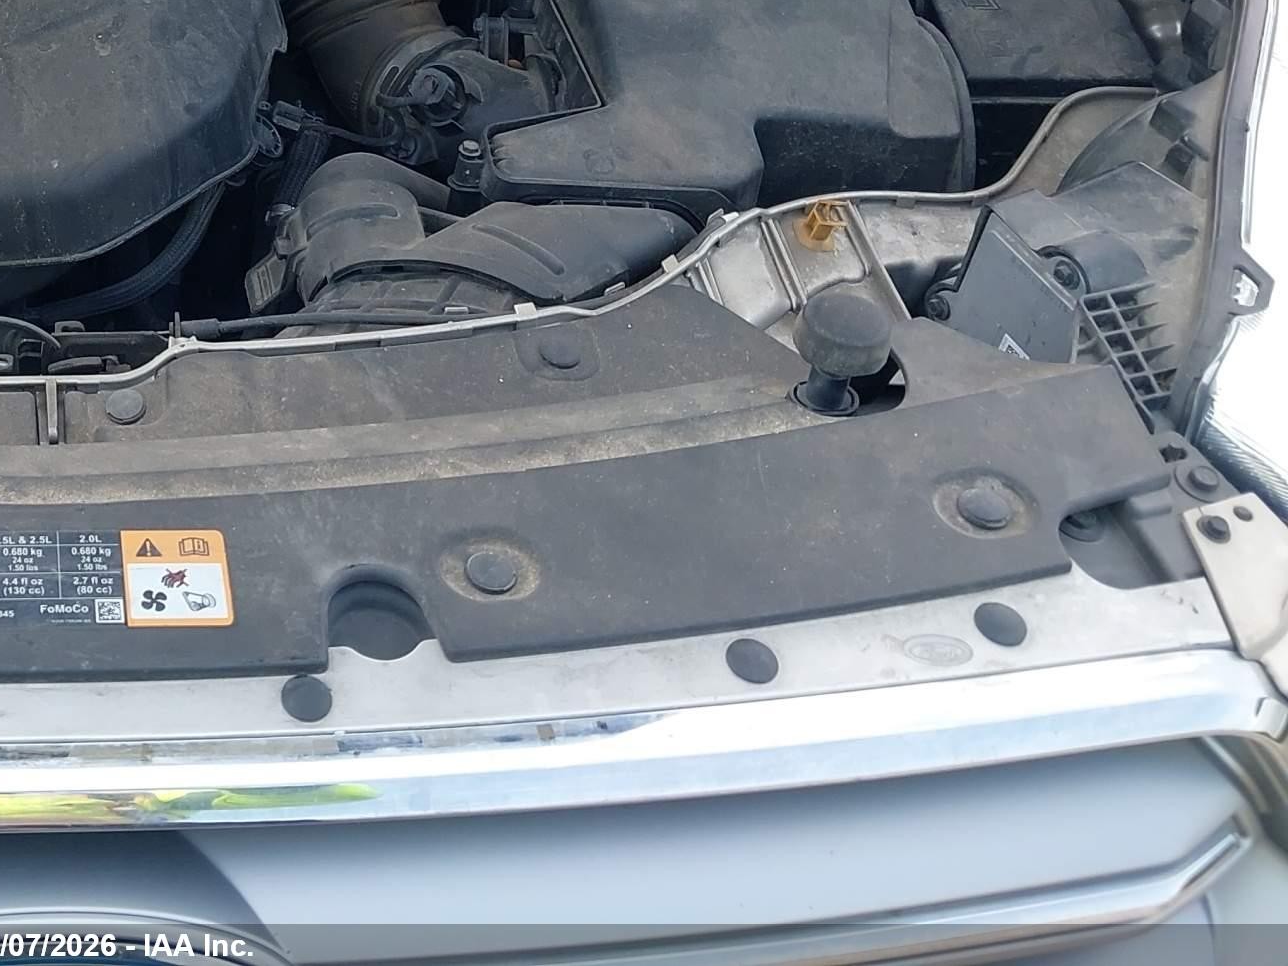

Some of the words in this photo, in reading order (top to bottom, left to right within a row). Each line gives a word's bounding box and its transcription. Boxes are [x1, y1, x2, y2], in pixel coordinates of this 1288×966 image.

[18, 535, 27, 545] &
[28, 535, 53, 544] 2.5L
[79, 534, 102, 544] 2.0L
[2, 547, 28, 557] 0.680
[29, 547, 43, 558] kg
[71, 546, 97, 556] 0.680
[98, 546, 112, 557] kg
[1, 576, 19, 586] 4.4
[30, 577, 43, 585] oz
[72, 576, 88, 586] 2.7
[100, 577, 114, 585] oz
[3, 586, 26, 596] (130
[28, 586, 45, 596] cc)
[76, 585, 94, 596] (80
[96, 585, 112, 595] cc)
[39, 603, 89, 615] FoMoCo
